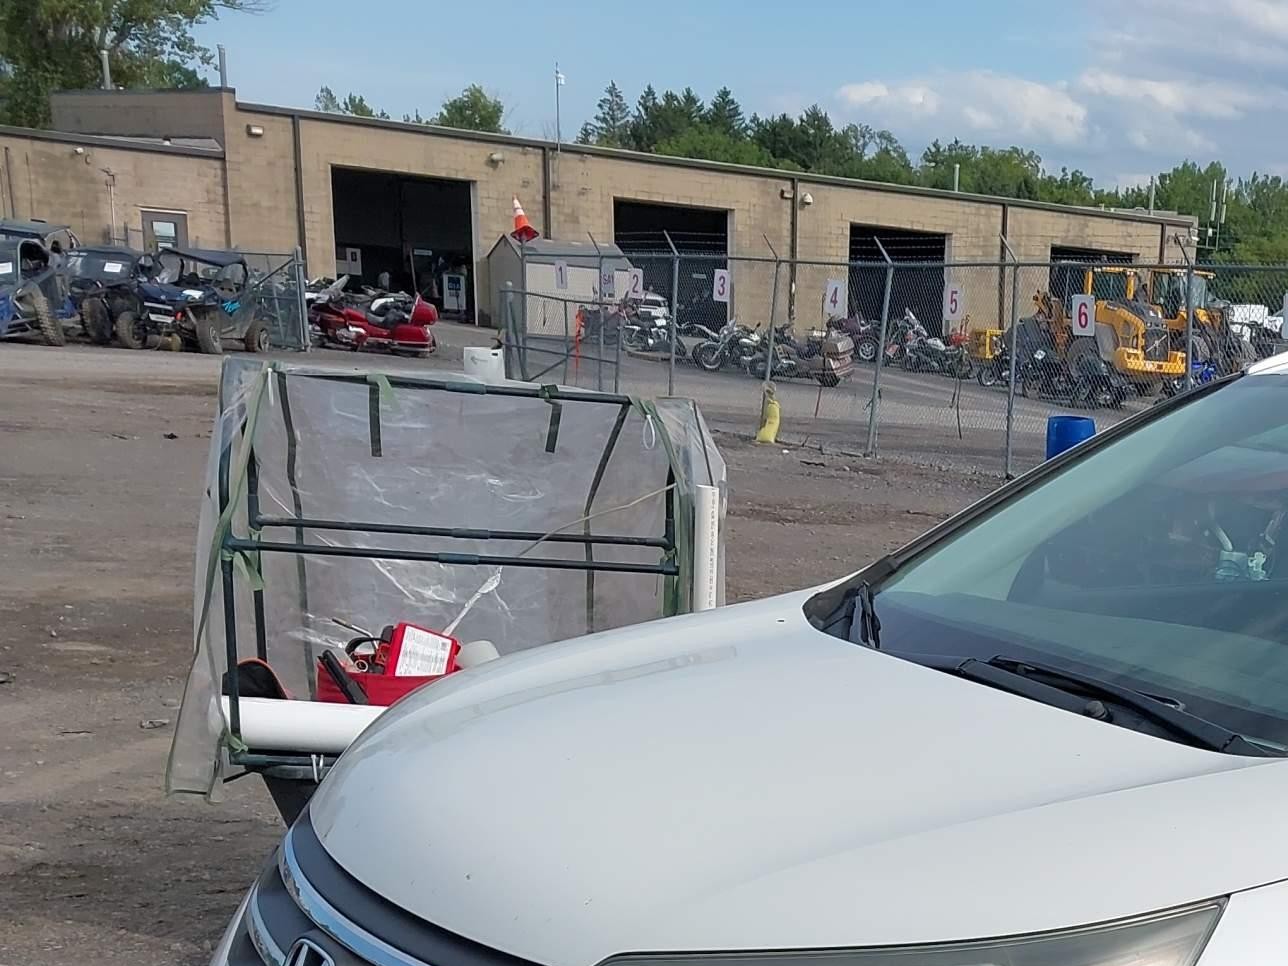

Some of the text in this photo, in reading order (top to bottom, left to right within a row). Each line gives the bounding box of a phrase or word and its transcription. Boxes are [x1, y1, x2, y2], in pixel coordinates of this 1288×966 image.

[558, 266, 564, 285] 1
[631, 273, 640, 293] 2
[718, 275, 726, 296] 3
[829, 286, 839, 308] 4
[949, 290, 958, 315] 5
[1077, 302, 1089, 329] 6
